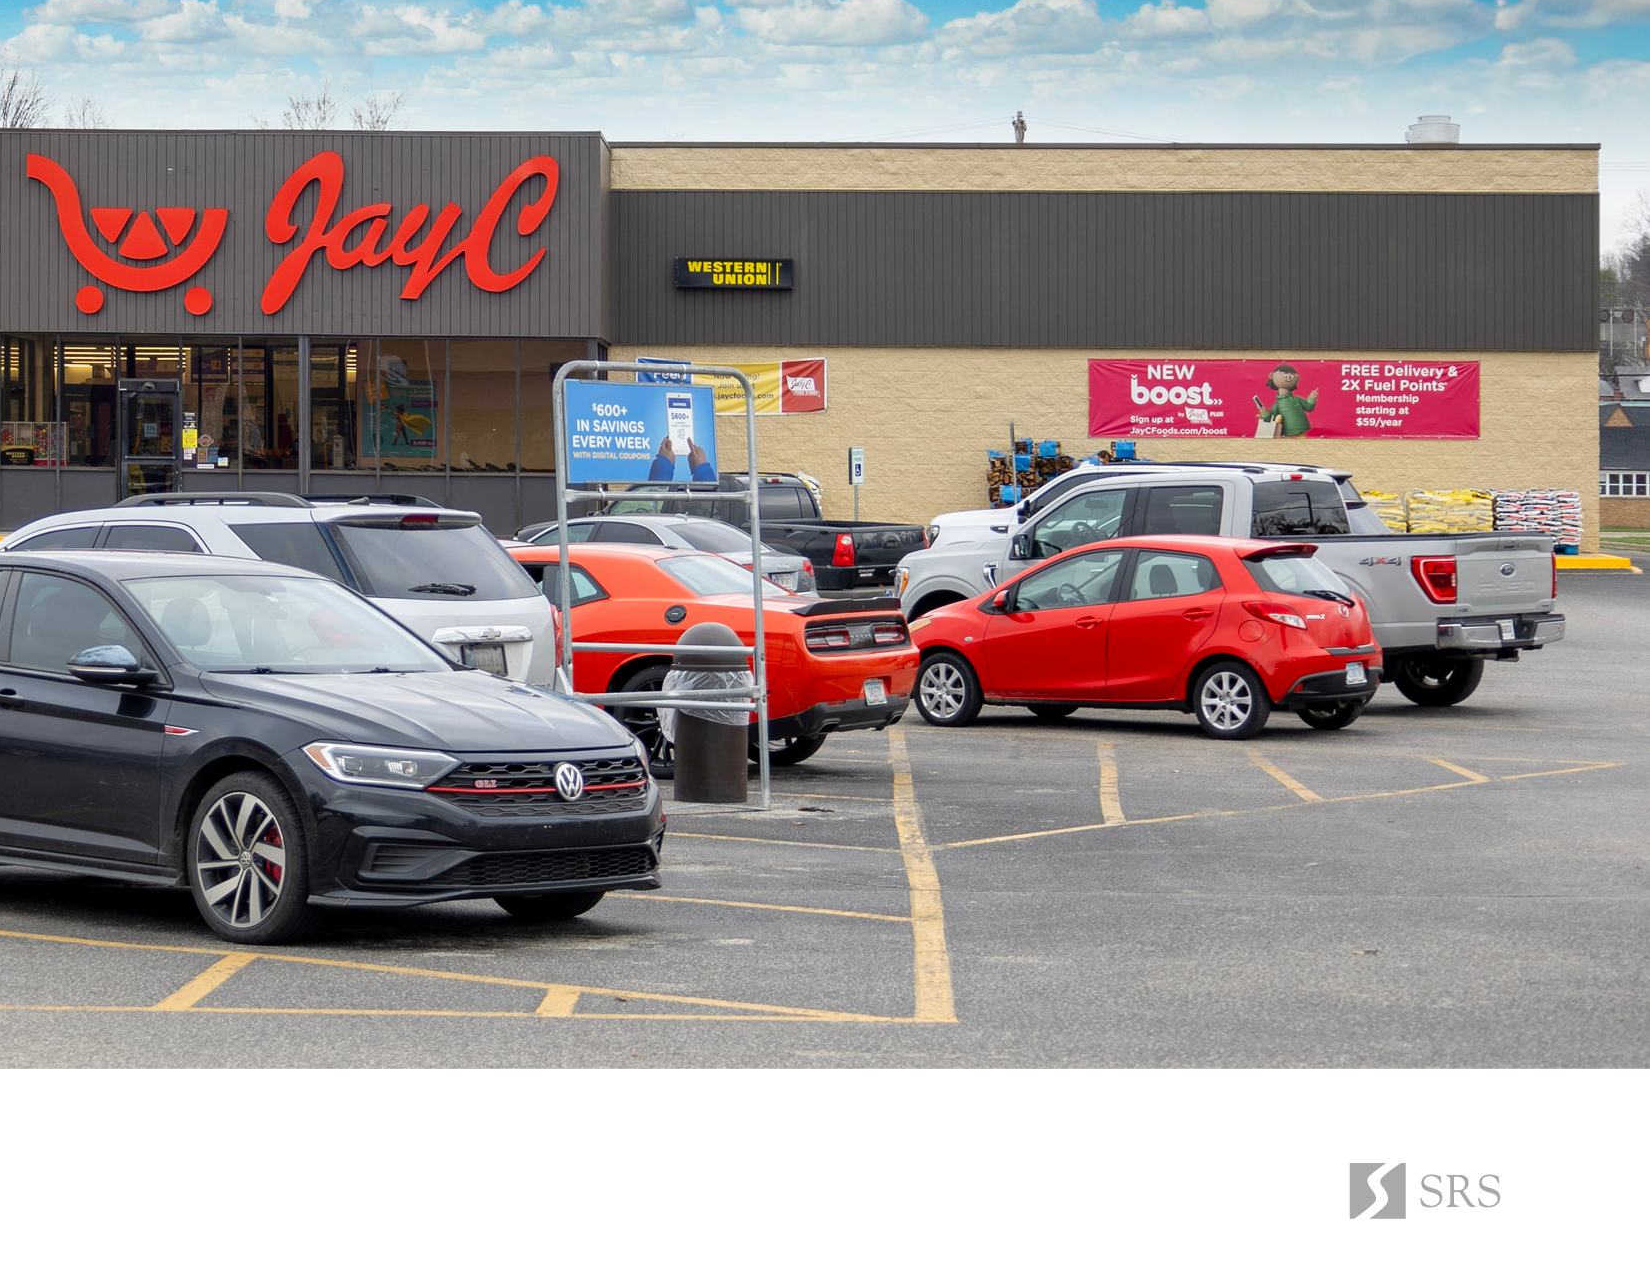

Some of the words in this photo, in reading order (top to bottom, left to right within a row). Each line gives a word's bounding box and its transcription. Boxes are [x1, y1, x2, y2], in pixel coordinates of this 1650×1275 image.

[261, 151, 559, 314] JayC
[687, 261, 767, 273] WESTERN
[713, 274, 767, 285] UNION
[653, 371, 686, 379] Feed
[1147, 364, 1195, 380] NEW
[1341, 365, 1380, 376] FREE
[1384, 364, 1444, 379] Delivery
[1447, 365, 1458, 377] &
[1131, 374, 1214, 405] boost
[1341, 379, 1360, 391] 2X
[1364, 379, 1395, 391] Fuel
[1356, 394, 1419, 404] Membership
[592, 403, 627, 417] $600+
[1356, 406, 1396, 416] starting
[1398, 406, 1409, 414] at
[670, 412, 689, 420] $600+
[1130, 415, 1149, 425] Sign
[1151, 417, 1163, 425] up
[577, 419, 589, 432] IN
[593, 420, 645, 433] SAVINGS
[1356, 417, 1403, 427] $59/year
[1130, 427, 1227, 436] JayCFoods.com/boost
[572, 435, 612, 448] EVERY
[615, 436, 650, 449] WEEK
[573, 451, 591, 459] WITH
[592, 451, 618, 459] DIGITAL
[619, 452, 651, 460] COUPONS
[475, 779, 497, 788] GLI
